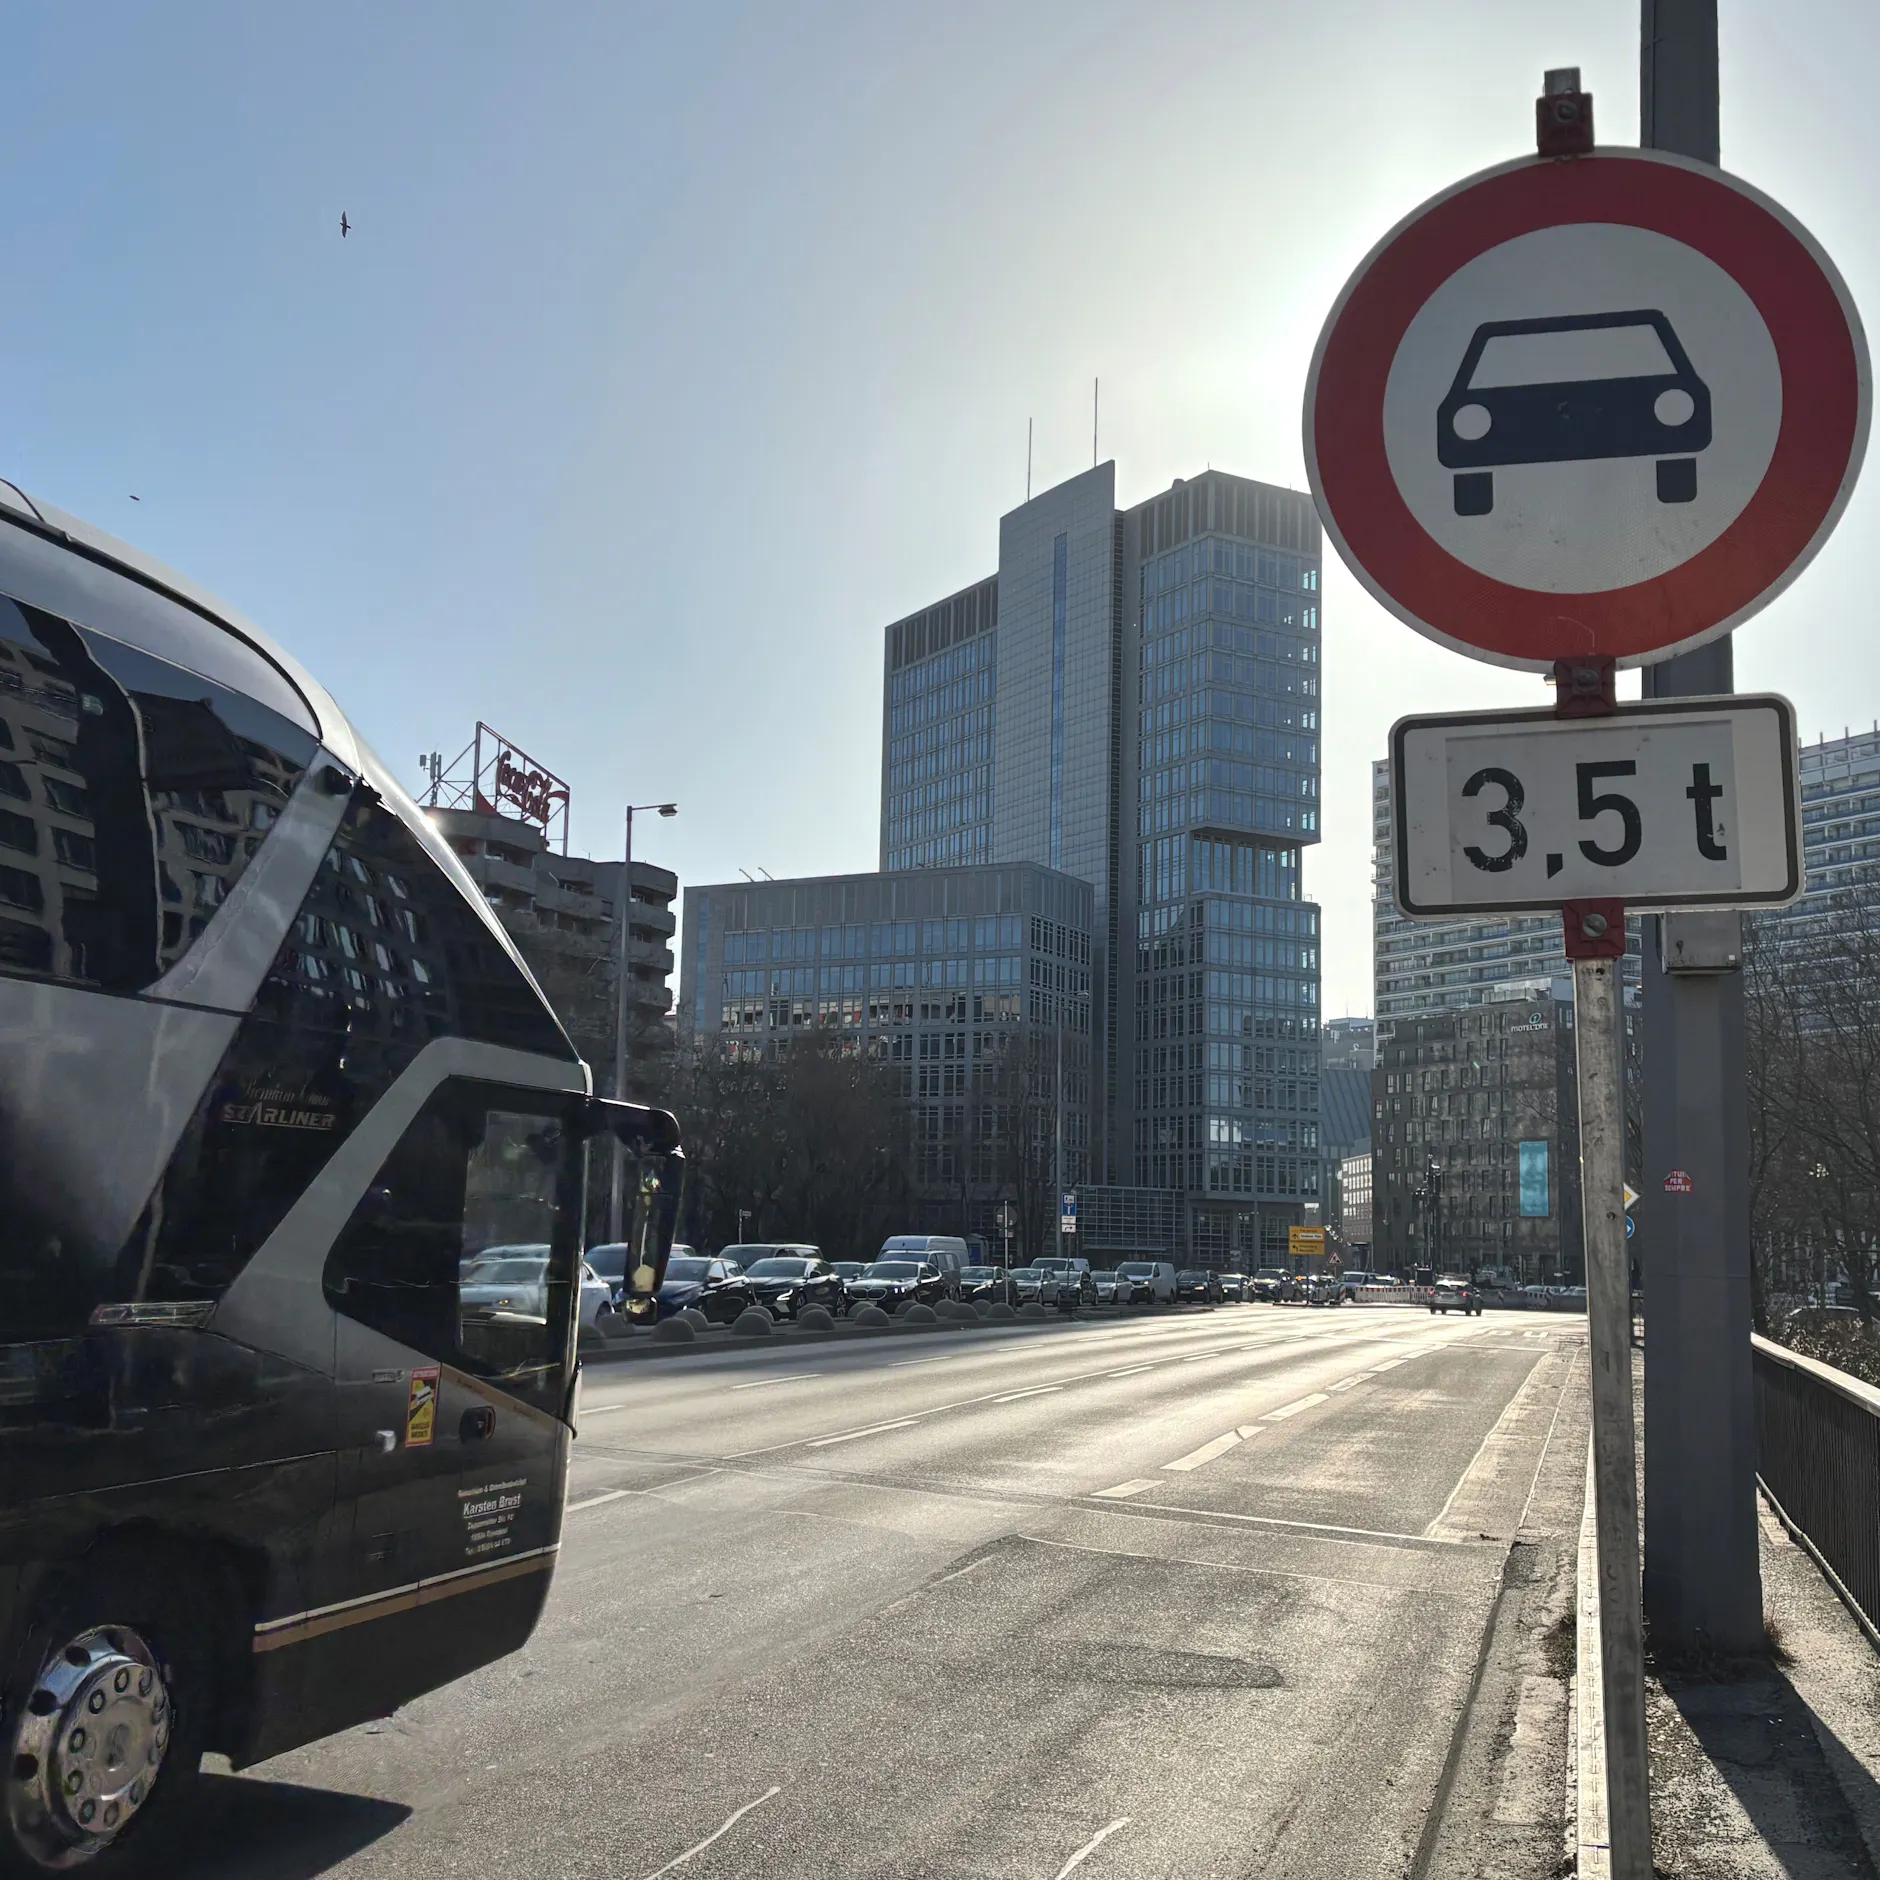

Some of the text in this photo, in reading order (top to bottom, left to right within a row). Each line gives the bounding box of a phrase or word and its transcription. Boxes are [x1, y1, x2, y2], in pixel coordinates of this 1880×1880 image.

[1461, 759, 1727, 879] 3,5 t
[223, 1101, 336, 1130] STARLINER
[463, 1500, 497, 1516] Karsten
